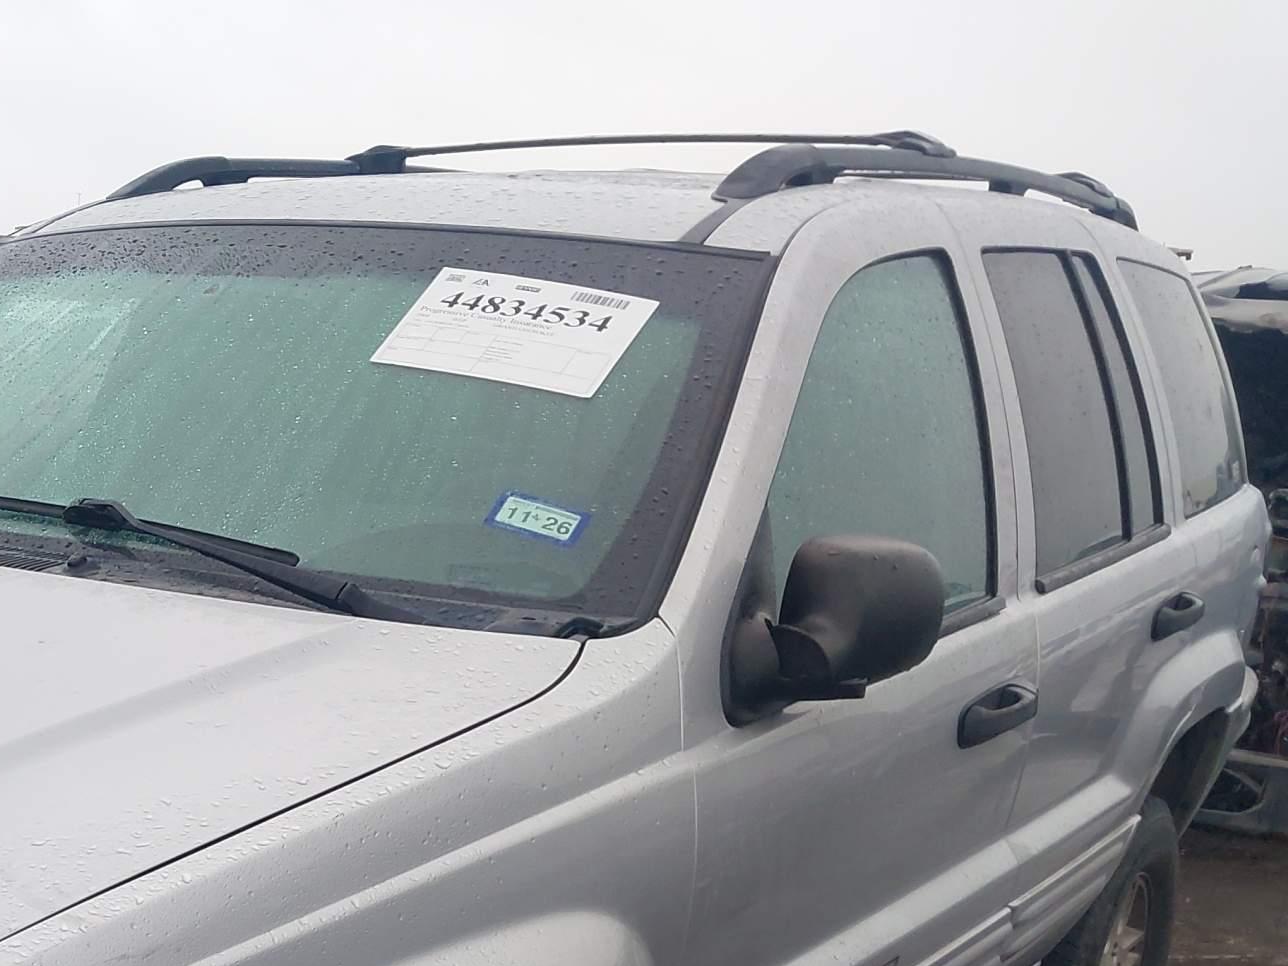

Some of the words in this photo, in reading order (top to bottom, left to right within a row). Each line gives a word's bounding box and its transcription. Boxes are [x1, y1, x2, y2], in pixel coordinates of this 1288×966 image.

[440, 291, 613, 332] 44834534
[507, 507, 532, 523] 11
[541, 516, 573, 535] 26
